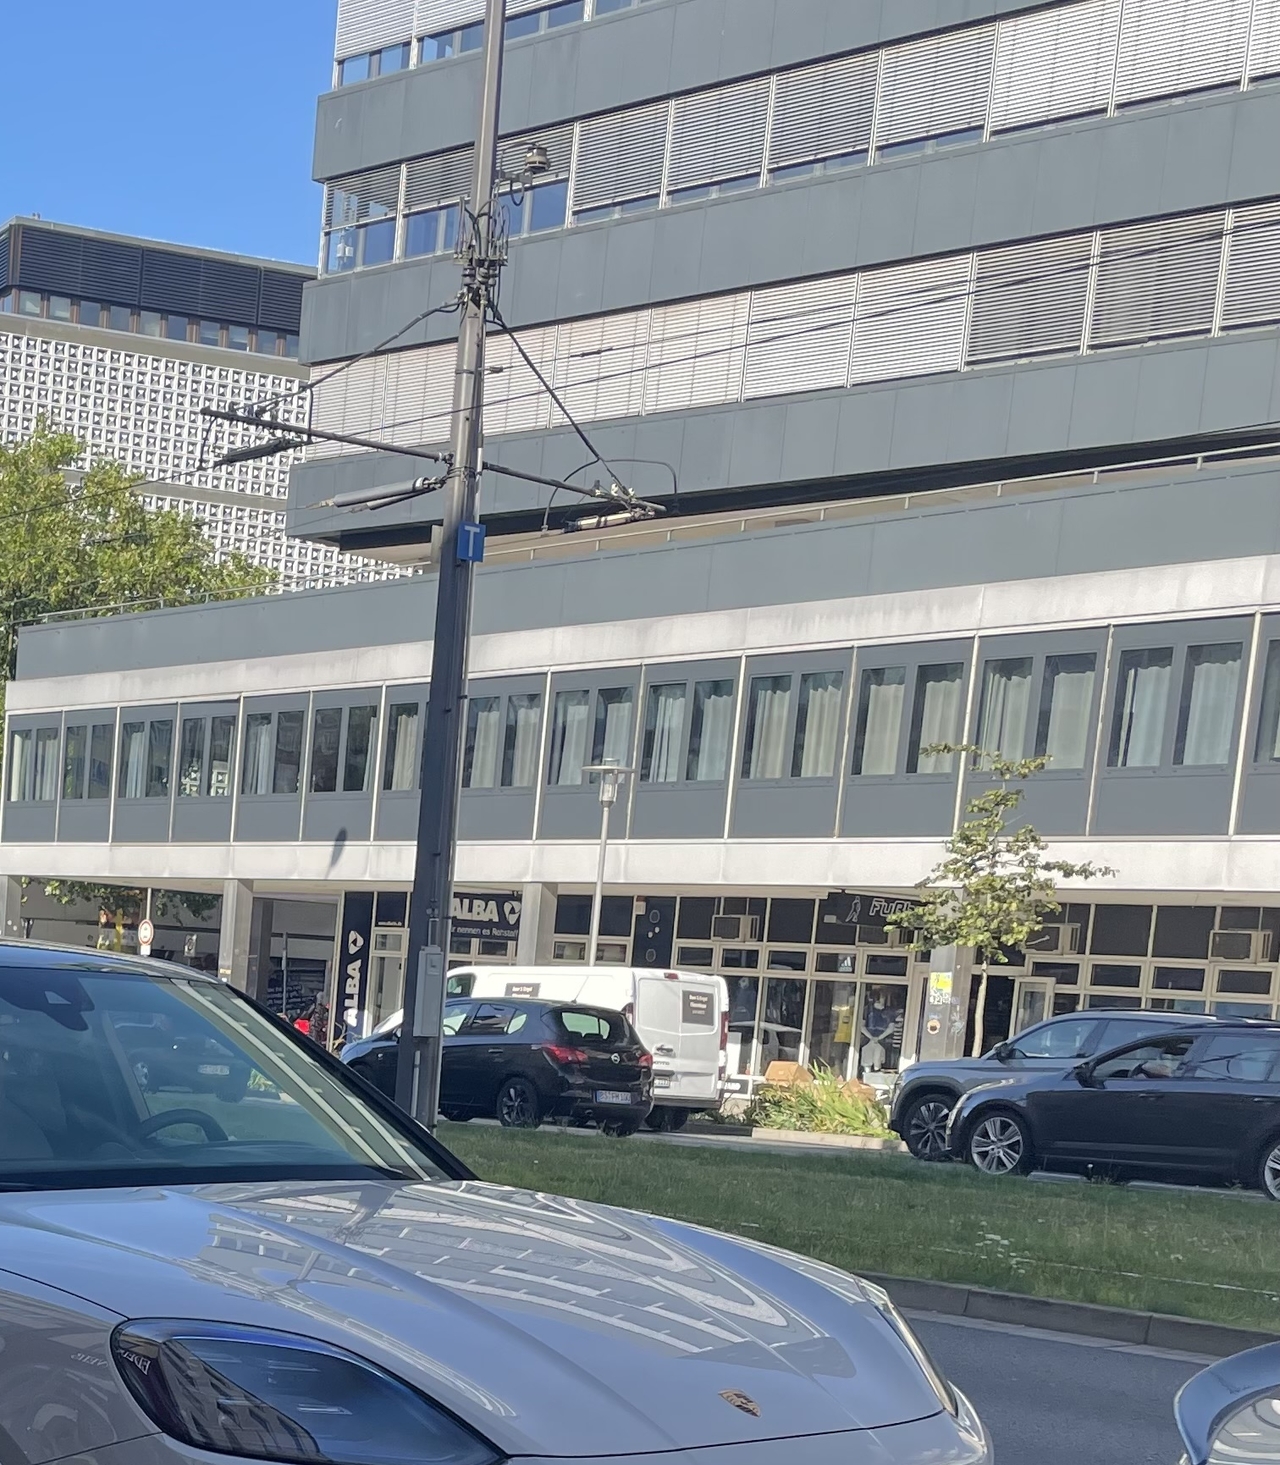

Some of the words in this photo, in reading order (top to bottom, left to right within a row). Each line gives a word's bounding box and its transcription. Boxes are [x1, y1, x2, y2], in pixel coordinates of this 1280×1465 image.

[464, 525, 481, 557] T
[452, 898, 499, 922] ALBA
[343, 959, 362, 1027] ALBA
